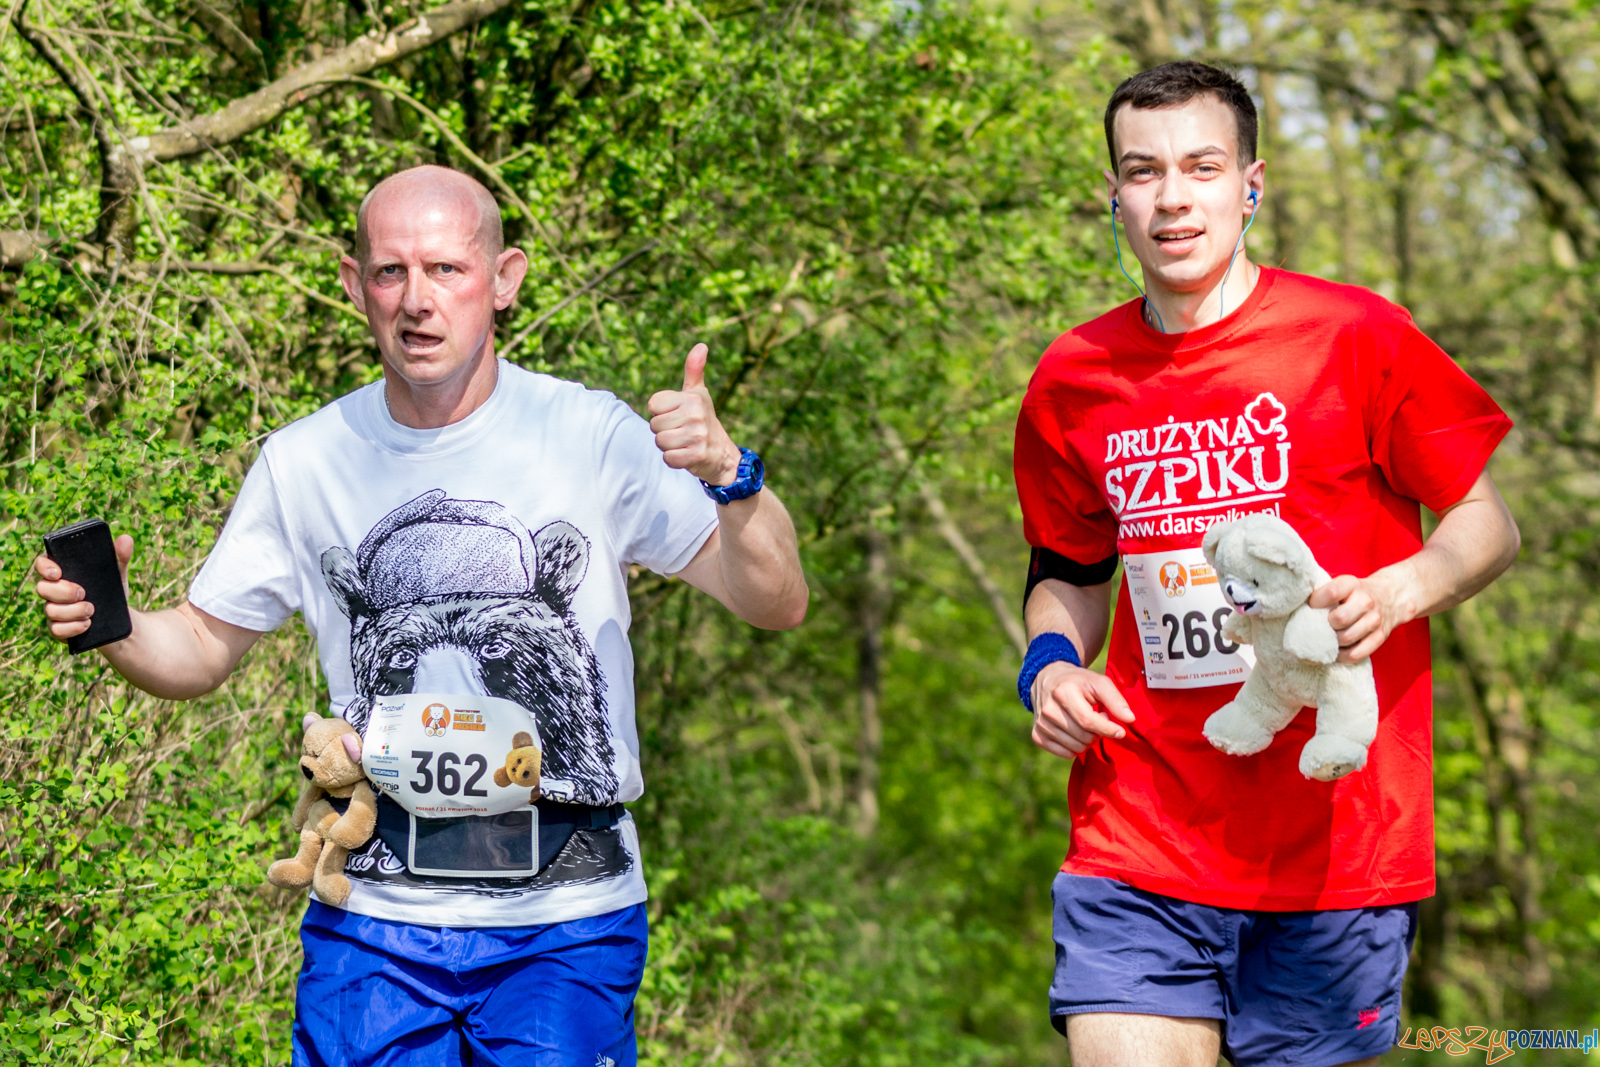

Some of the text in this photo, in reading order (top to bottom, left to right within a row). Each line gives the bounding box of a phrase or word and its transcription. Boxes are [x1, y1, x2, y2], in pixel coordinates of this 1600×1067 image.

[1105, 415, 1255, 463] DRUŻYNA
[1105, 442, 1292, 515] SZPIKU
[1162, 606, 1241, 660] 268
[1228, 667, 1244, 675] 2018
[409, 750, 488, 797] 362
